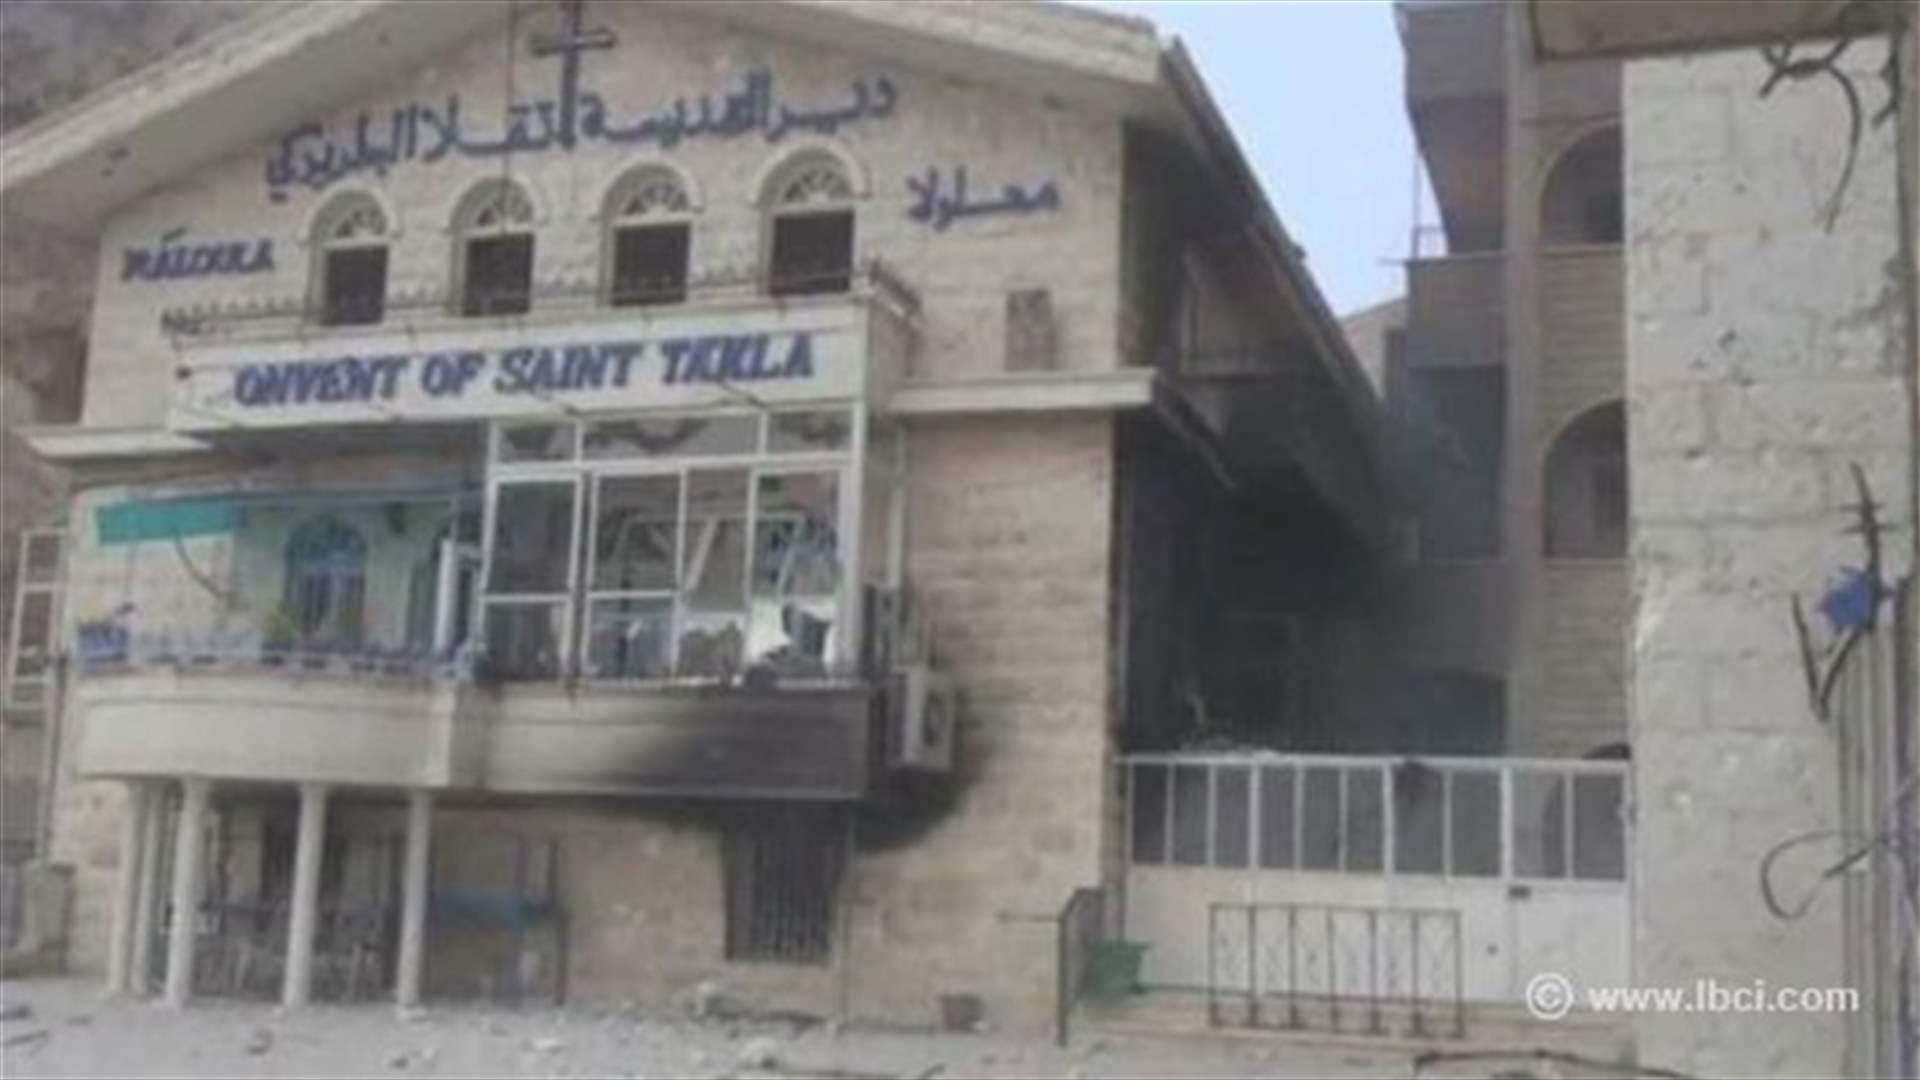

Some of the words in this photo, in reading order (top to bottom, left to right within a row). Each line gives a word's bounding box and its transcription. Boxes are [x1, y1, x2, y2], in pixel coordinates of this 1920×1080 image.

[764, 76, 897, 143] دير
[420, 350, 487, 396] OF
[492, 343, 645, 393] SAINT
